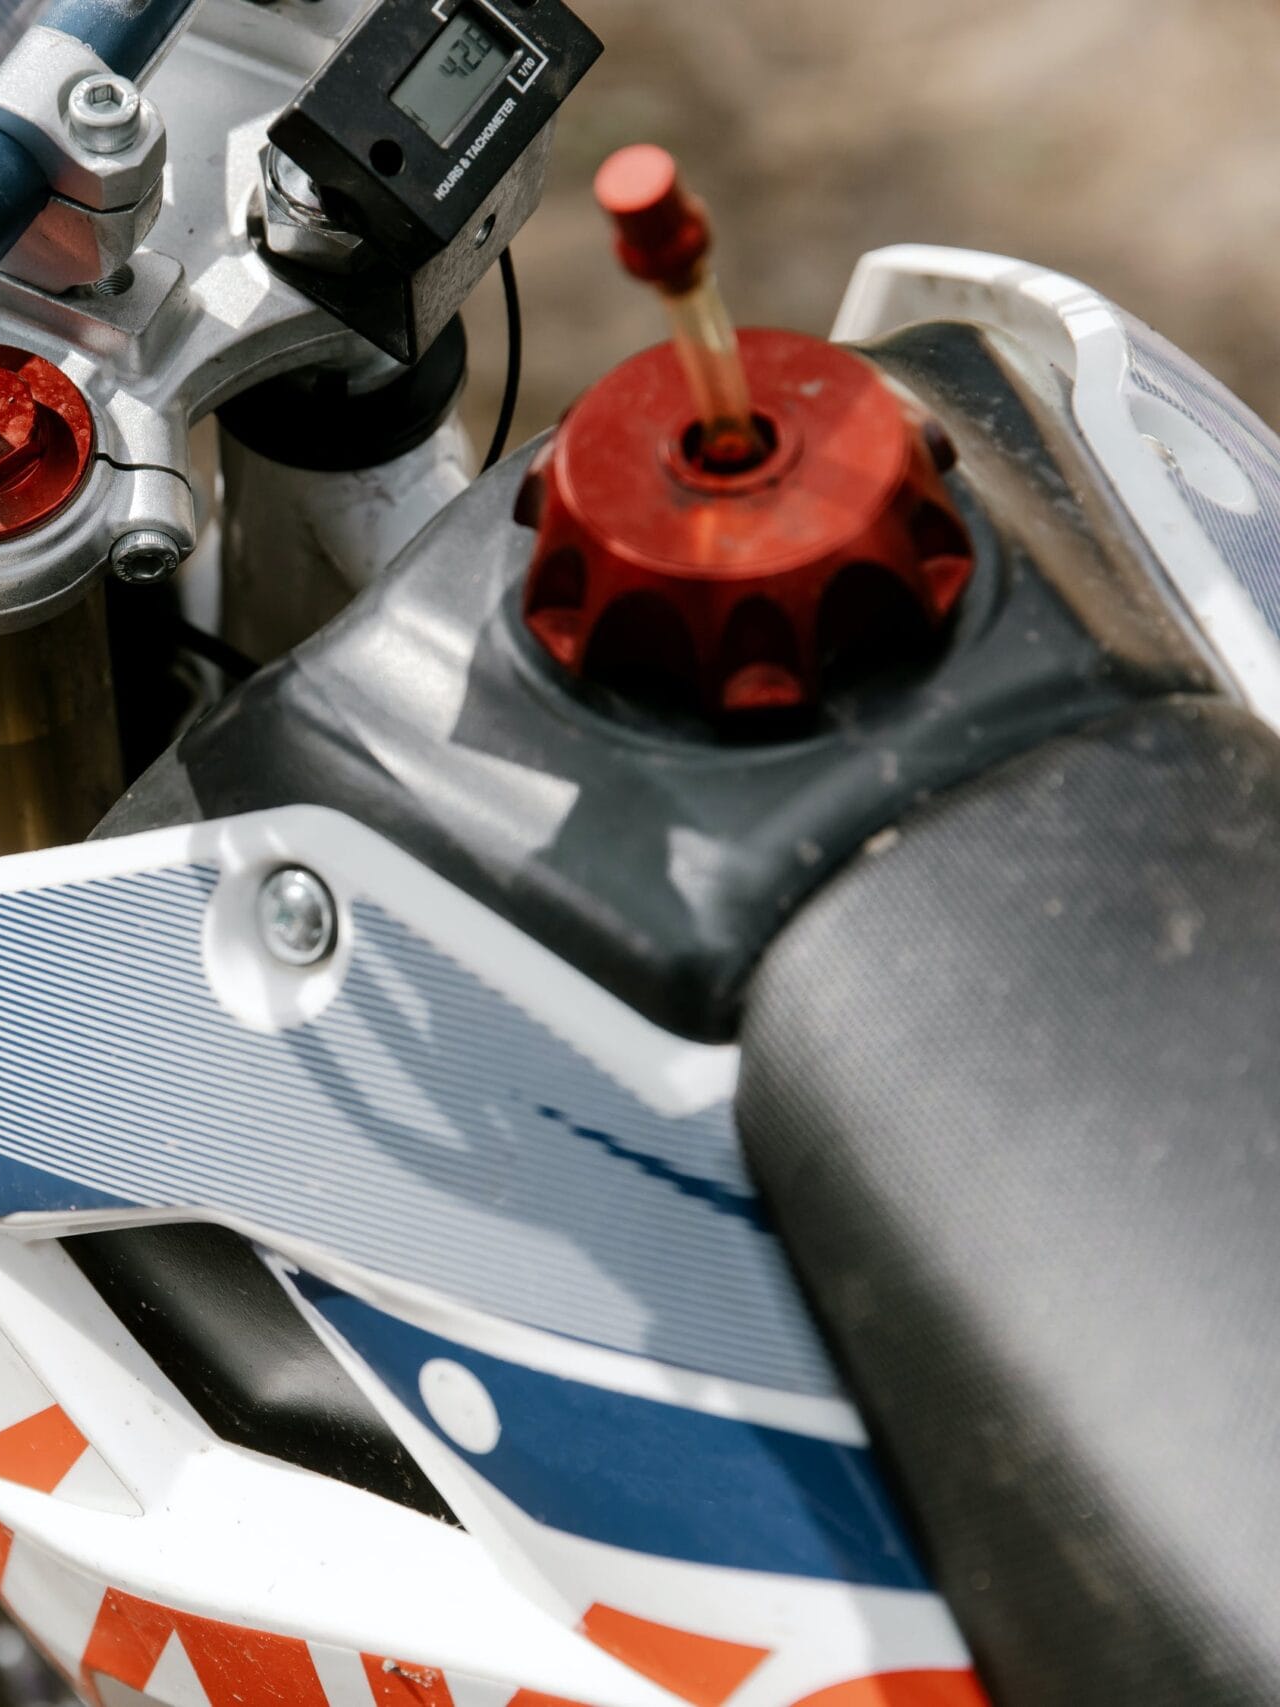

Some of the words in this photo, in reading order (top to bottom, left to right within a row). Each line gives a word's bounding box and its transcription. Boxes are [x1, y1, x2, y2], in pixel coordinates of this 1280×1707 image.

[517, 57, 536, 77] 1/10
[433, 165, 465, 201] HOURS
[458, 157, 470, 170] &
[464, 97, 517, 160] TACHOMETER
